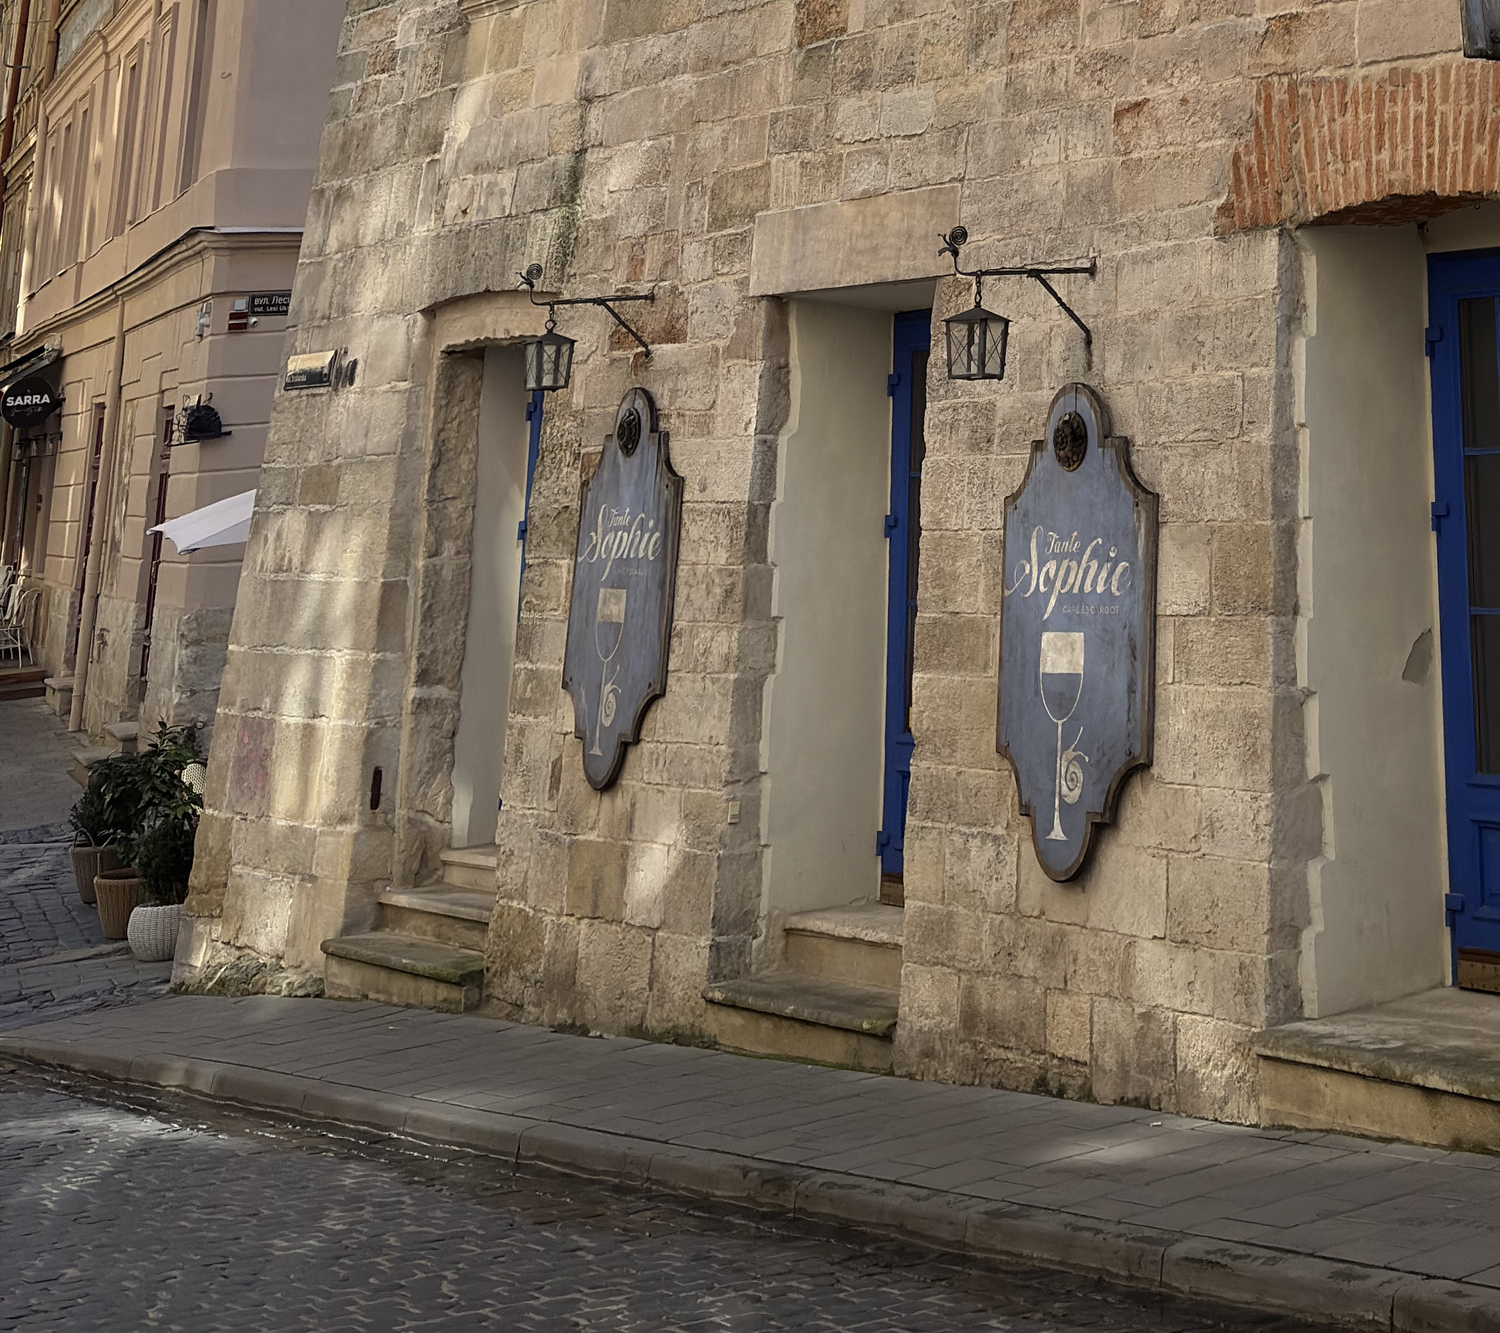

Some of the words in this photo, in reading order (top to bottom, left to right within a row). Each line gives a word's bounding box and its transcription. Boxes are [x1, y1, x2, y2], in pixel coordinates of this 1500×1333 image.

[6, 394, 51, 407] SARRA
[608, 507, 631, 528] Tante
[577, 503, 662, 582] Sophie
[1045, 531, 1081, 555] Tante
[1003, 525, 1131, 621] Sophie
